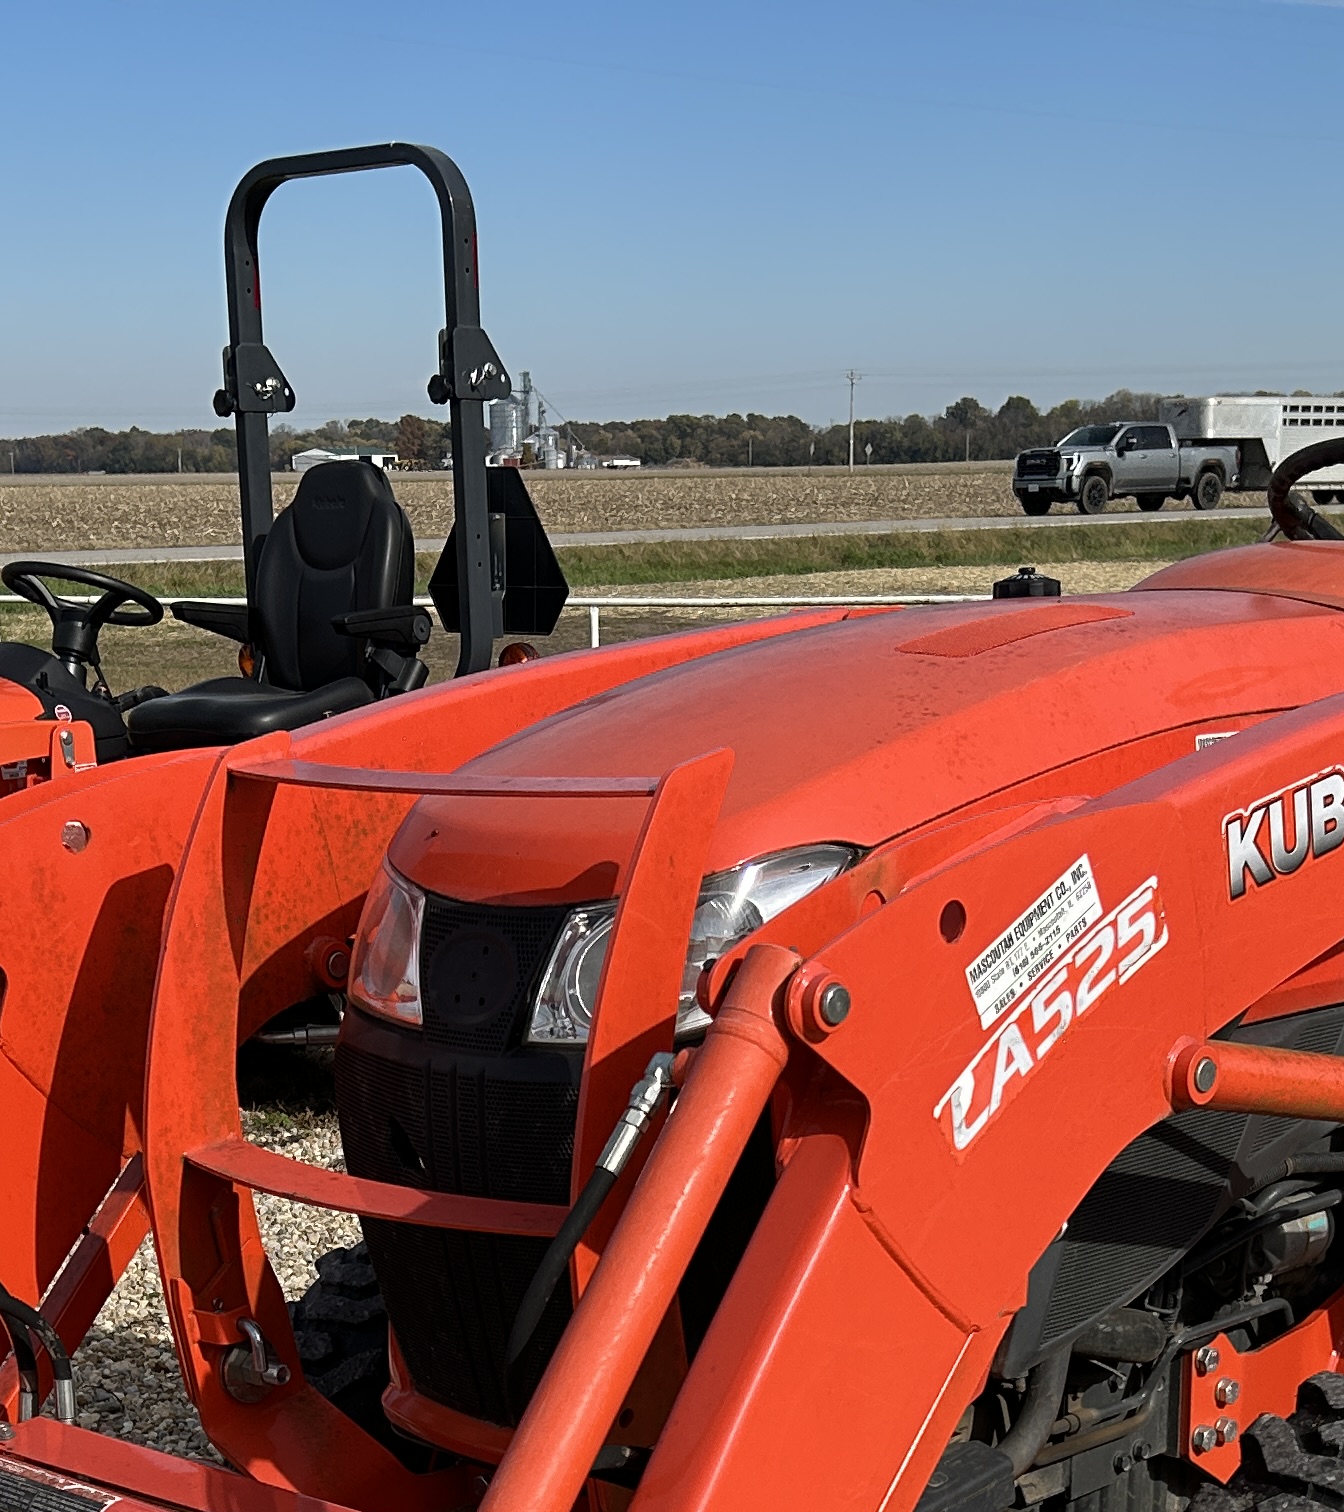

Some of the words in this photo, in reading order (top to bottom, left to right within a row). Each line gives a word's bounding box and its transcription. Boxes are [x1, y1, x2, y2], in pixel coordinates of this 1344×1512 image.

[968, 930, 1014, 986] MASCOUTAH
[1014, 891, 1055, 943] EQUIPMENT
[994, 987, 1017, 1015] SALES
[1026, 949, 1055, 983] SERVICE
[1065, 916, 1088, 945] PARTS
[949, 885, 1159, 1151] LA525
